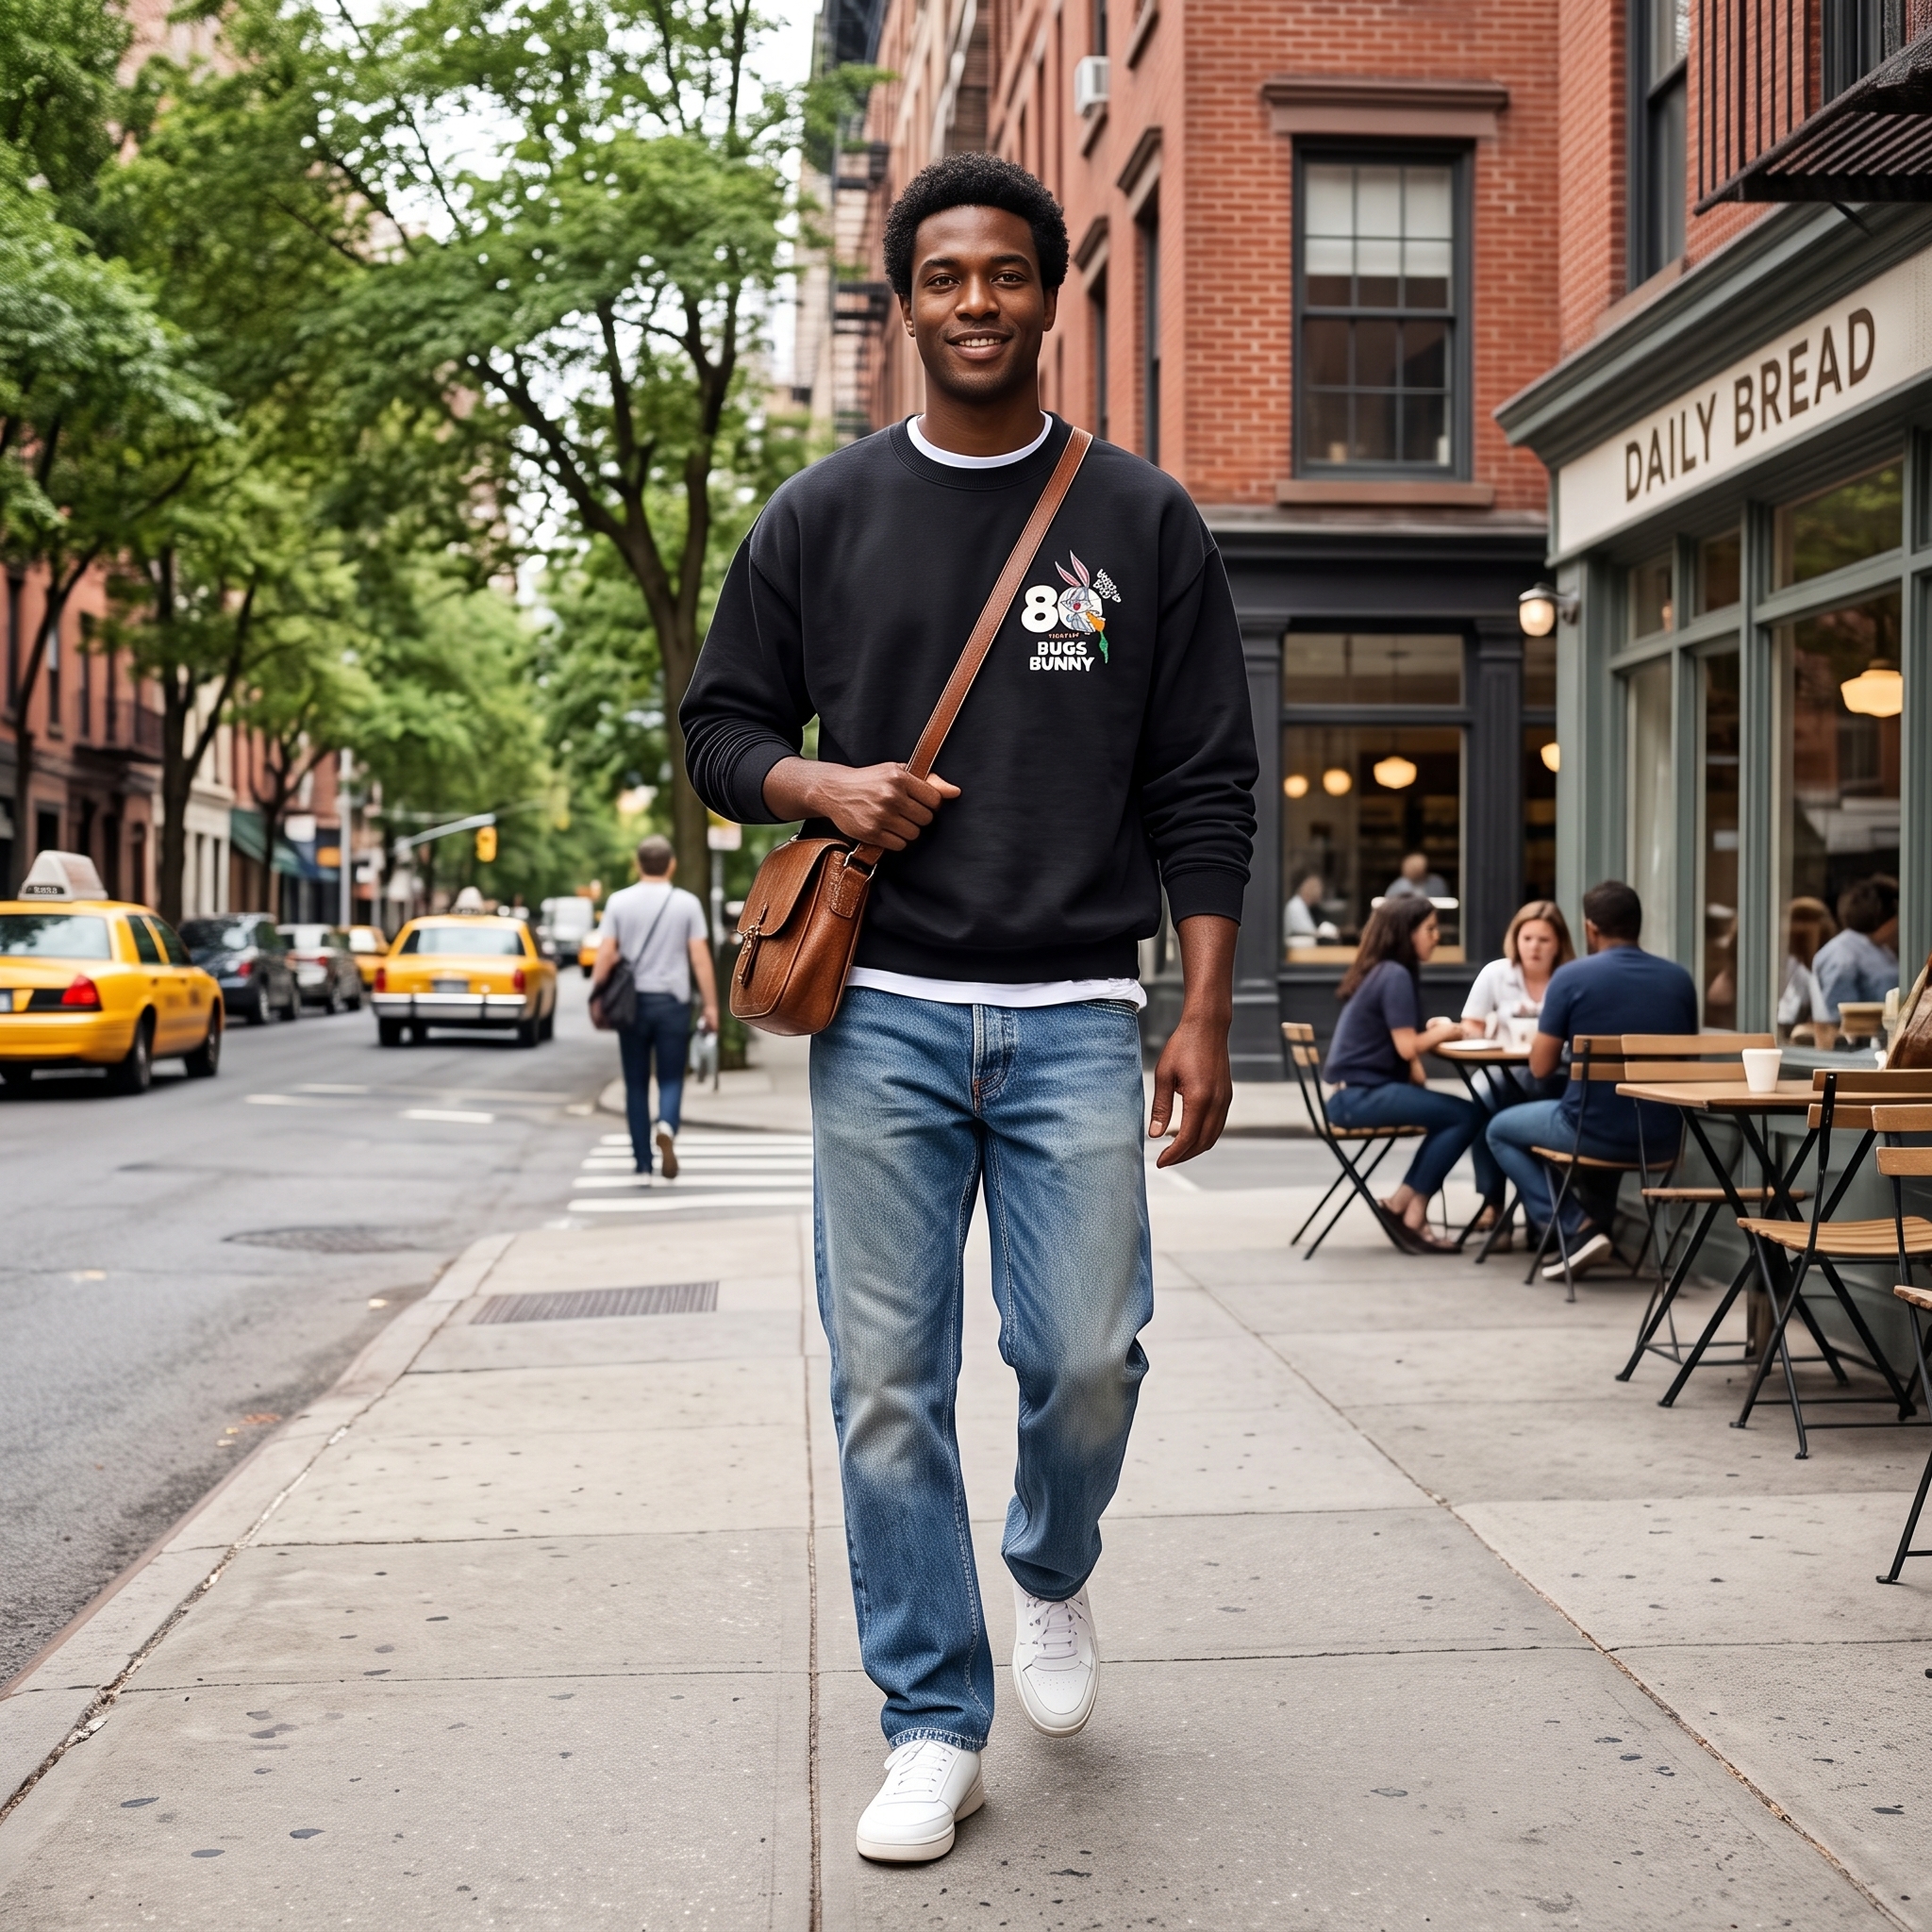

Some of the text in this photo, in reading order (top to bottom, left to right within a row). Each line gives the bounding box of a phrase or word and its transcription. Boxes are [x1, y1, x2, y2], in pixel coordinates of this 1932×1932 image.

[1624, 307, 1875, 504] DAILY BREAD
[1021, 585, 1104, 633] 80
[1029, 656, 1095, 672] BUNNY
[1037, 641, 1088, 656] BUGS
